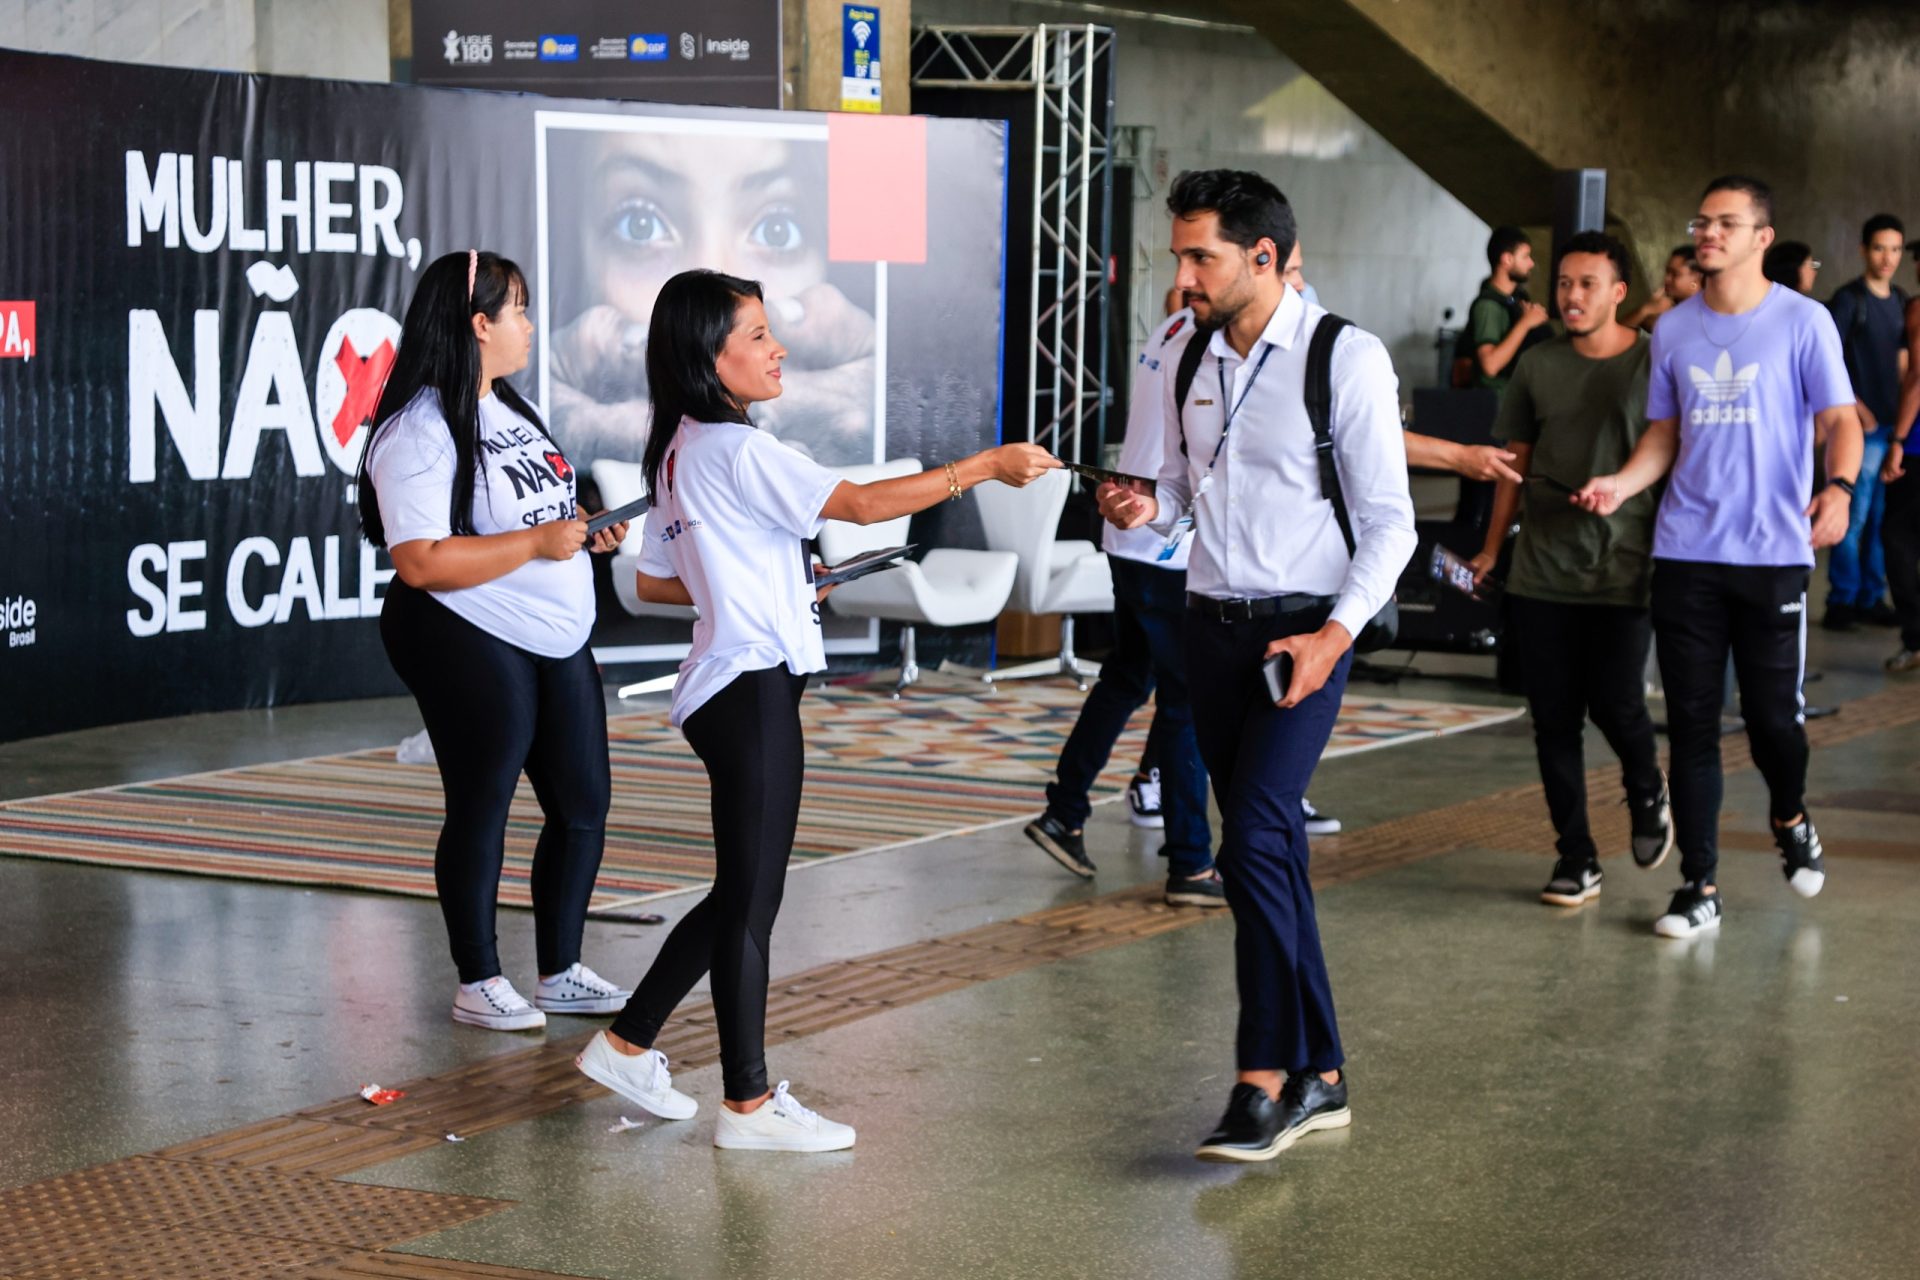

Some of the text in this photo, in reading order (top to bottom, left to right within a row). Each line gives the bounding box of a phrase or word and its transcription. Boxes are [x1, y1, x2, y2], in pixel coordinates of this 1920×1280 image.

[461, 35, 493, 45] LIGUE
[706, 38, 749, 53] Inside
[461, 45, 493, 63] 180
[126, 150, 422, 271] MULHER,
[129, 260, 402, 483] NÃO
[1689, 403, 1757, 425] adidas
[127, 535, 396, 637] SE CALE
[9, 627, 36, 648] Brasil
